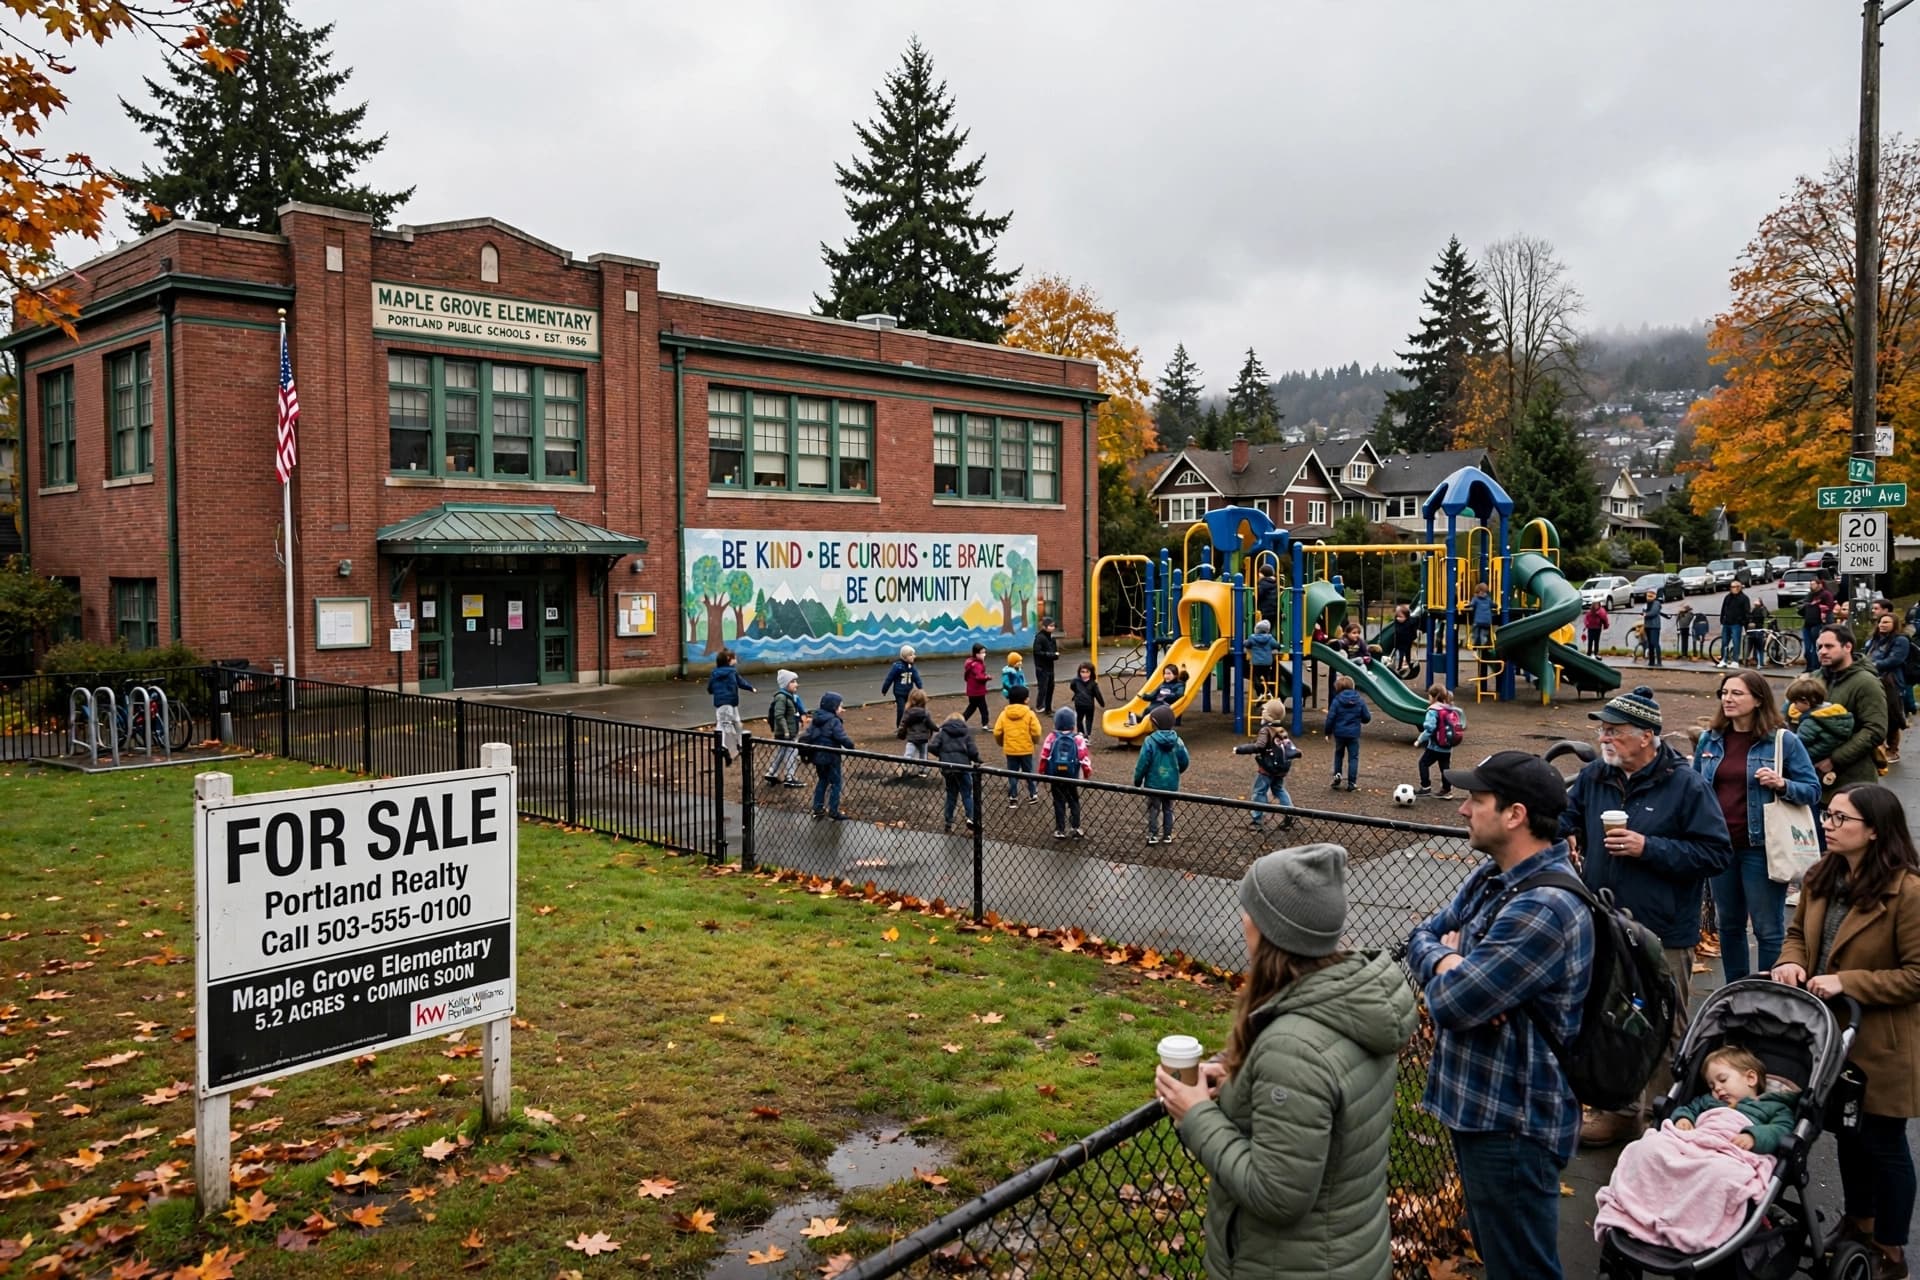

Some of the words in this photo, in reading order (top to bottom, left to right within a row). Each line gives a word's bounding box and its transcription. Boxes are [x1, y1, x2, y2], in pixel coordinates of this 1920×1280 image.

[379, 288, 434, 312] MAPLE
[440, 296, 492, 318] GROVE
[498, 304, 592, 331] ELEMENTARY
[388, 315, 443, 330] PORTLAND
[448, 321, 482, 334] PUBLIC
[488, 327, 531, 340] SCHOOLS
[544, 333, 562, 343] EST.
[567, 336, 587, 346] 1956
[1822, 492, 1837, 505] SE
[1843, 488, 1871, 505] 28th
[1879, 489, 1900, 503] Ave
[1849, 518, 1876, 537] 20
[722, 540, 747, 568] BE
[756, 541, 802, 569] KIND
[819, 542, 841, 568] BE
[847, 542, 918, 568] CURIOUS
[933, 543, 951, 568] BE
[958, 544, 1005, 568] BRAVE
[1844, 543, 1881, 553] SCHOOL
[1850, 557, 1874, 567] ZONE
[846, 576, 868, 603] BE
[875, 575, 971, 603] COMMUNITY
[227, 807, 346, 884] FOR
[367, 787, 497, 860] SALE
[265, 874, 381, 919] Portland
[392, 862, 468, 897] Realty
[262, 924, 308, 956] Call
[317, 894, 472, 945] 503-555-0100
[232, 978, 305, 1013] Maple
[312, 962, 374, 993] Grove
[382, 937, 492, 977] Elementary
[255, 1009, 283, 1031] 5.2
[288, 993, 345, 1024] ACRES
[367, 973, 429, 1004] COMING
[434, 962, 475, 986] SOON
